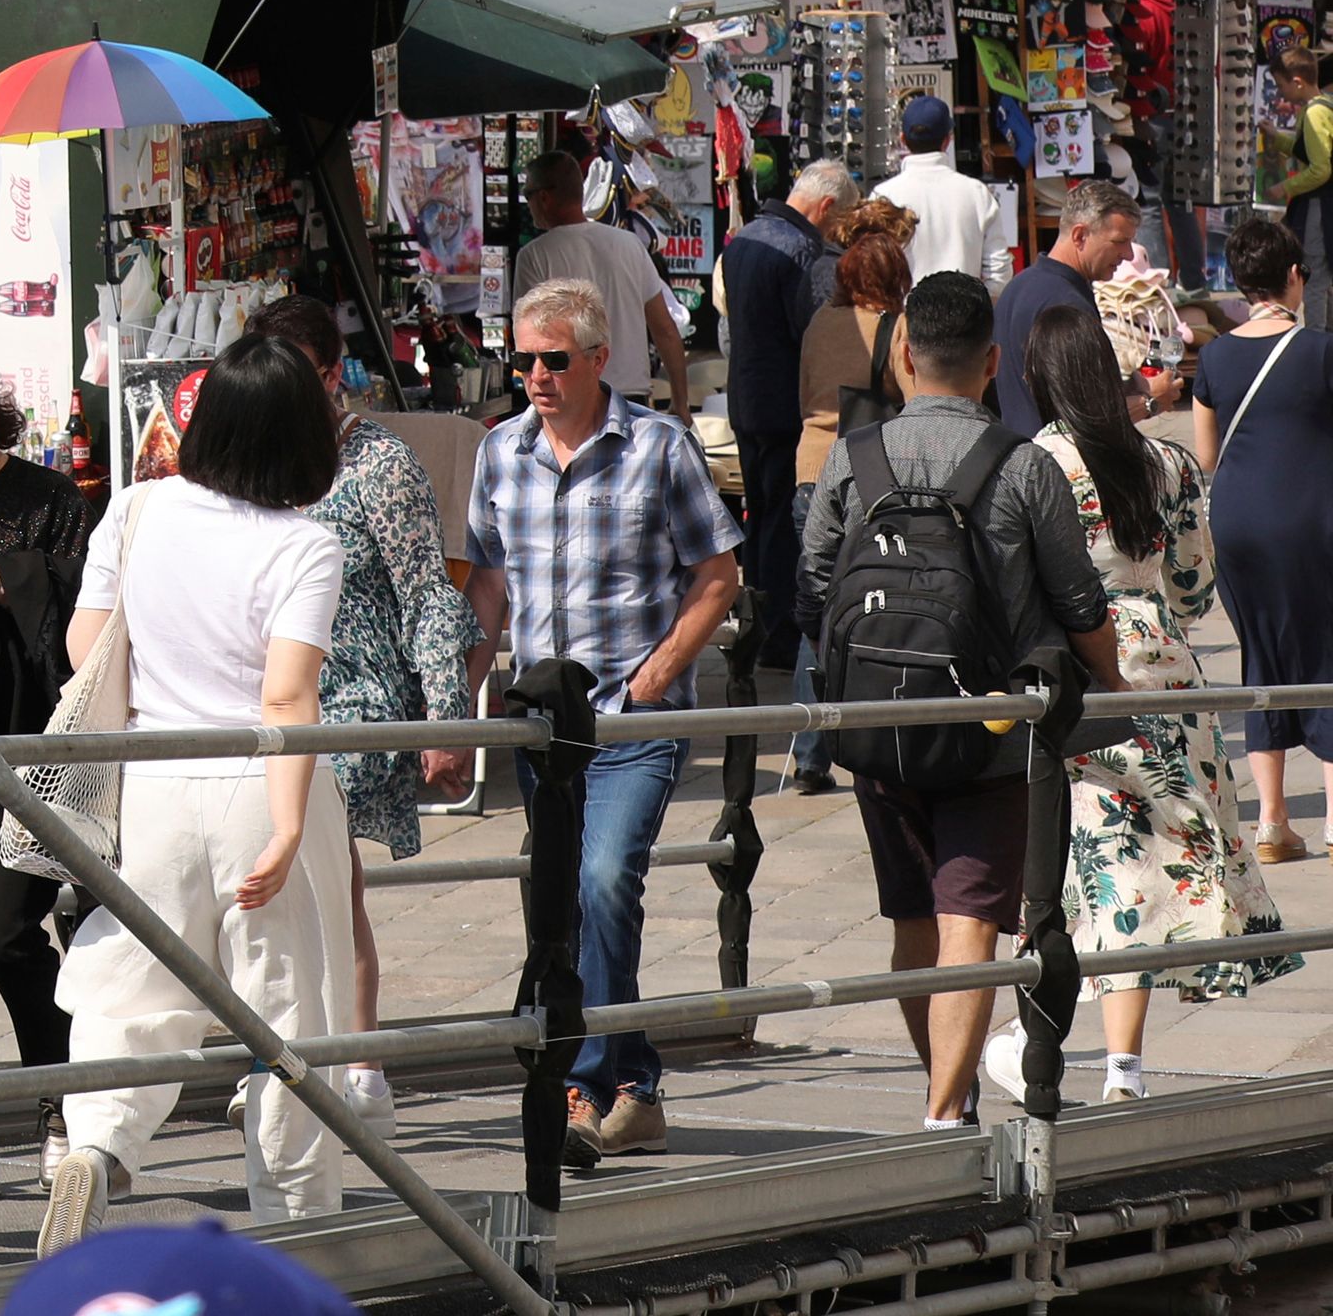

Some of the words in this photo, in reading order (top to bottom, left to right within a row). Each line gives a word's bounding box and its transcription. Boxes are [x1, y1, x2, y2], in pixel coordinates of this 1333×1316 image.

[957, 6, 1018, 25] MINECRAFT
[661, 236, 704, 258] ANG
[180, 391, 193, 422] QUI
